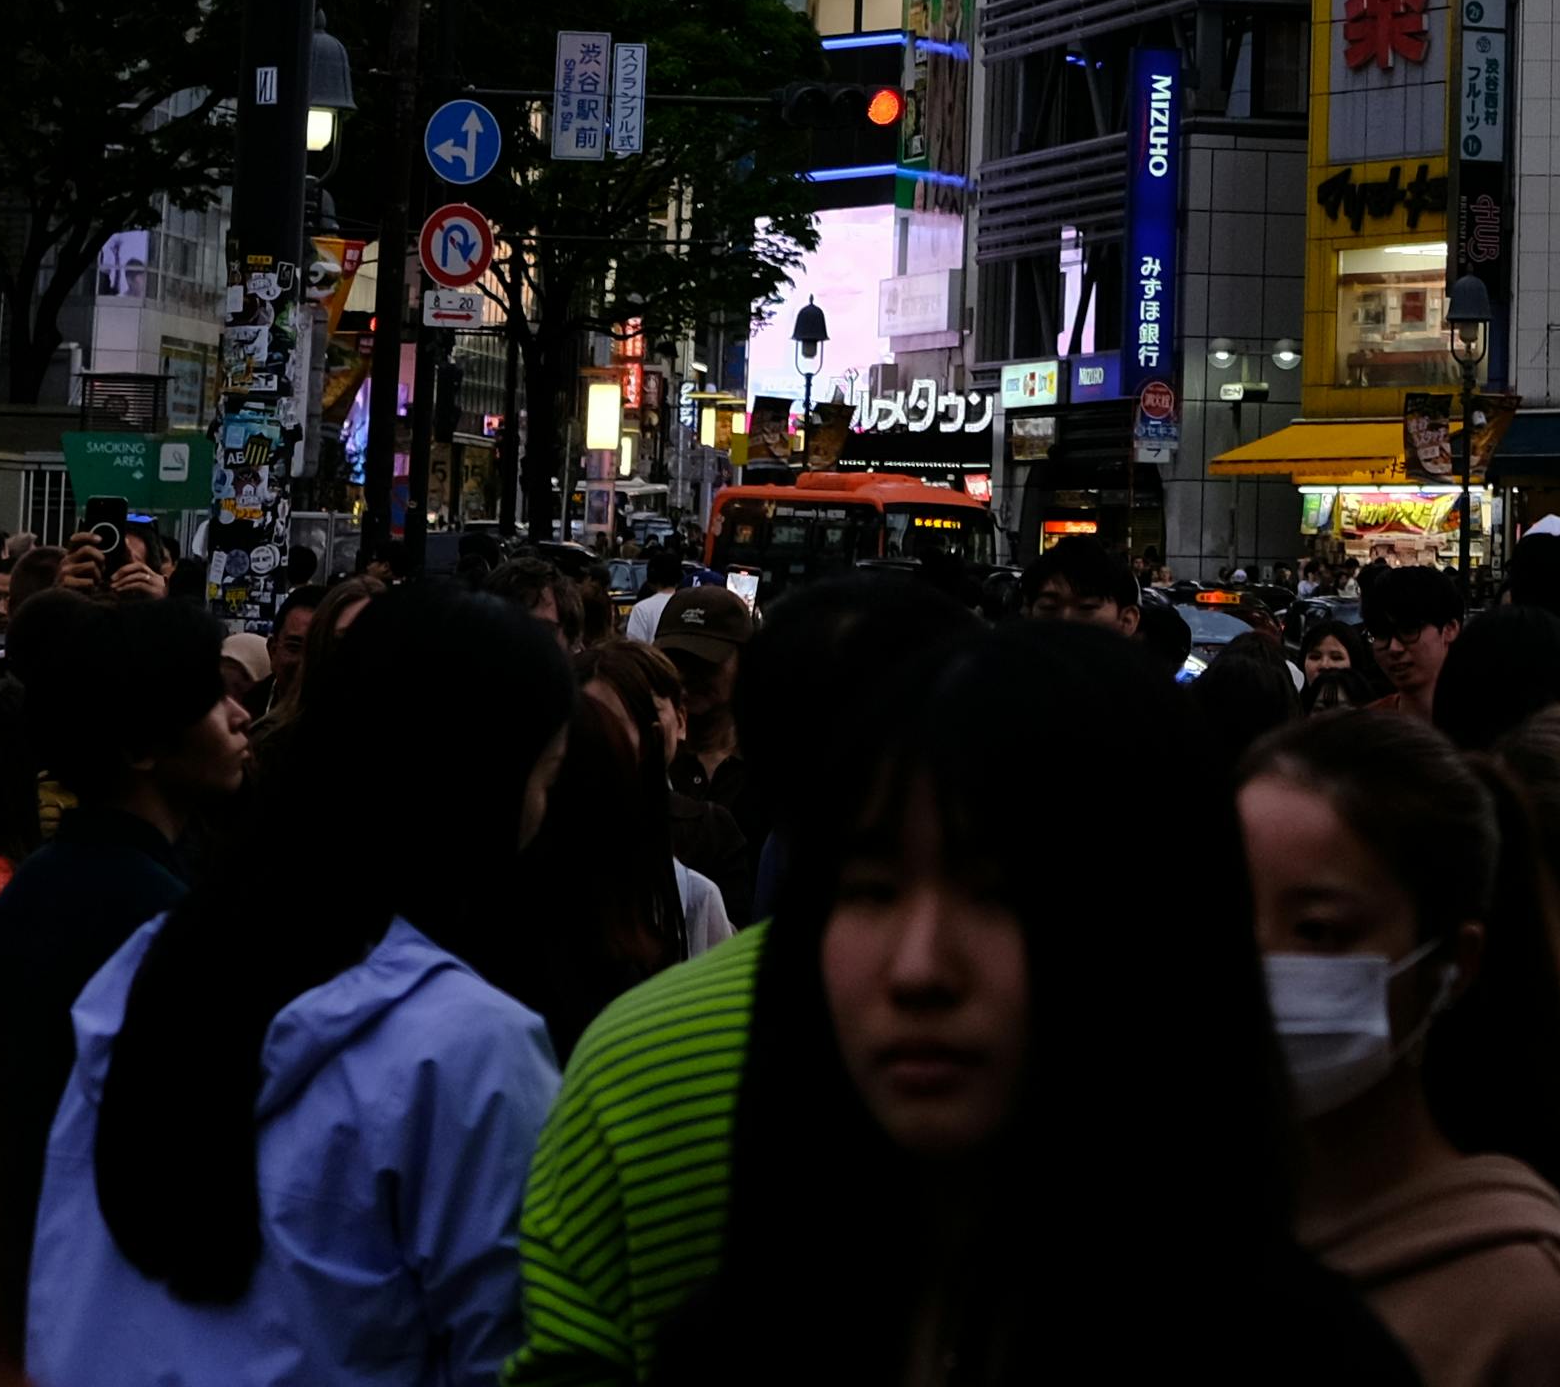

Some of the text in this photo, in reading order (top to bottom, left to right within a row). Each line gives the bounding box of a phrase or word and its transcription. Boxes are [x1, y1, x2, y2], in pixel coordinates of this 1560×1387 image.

[562, 58, 576, 107] Shibuya
[574, 44, 601, 149] 渋谷駅前
[618, 48, 637, 149] スクランブル式
[1466, 66, 1481, 131] フルーツ
[1148, 75, 1173, 177] MIZUHO
[1467, 193, 1501, 263] HUB
[1138, 255, 1162, 368] みずほ銀行
[86, 441, 146, 455] SMOKING
[113, 455, 145, 468] AREA
